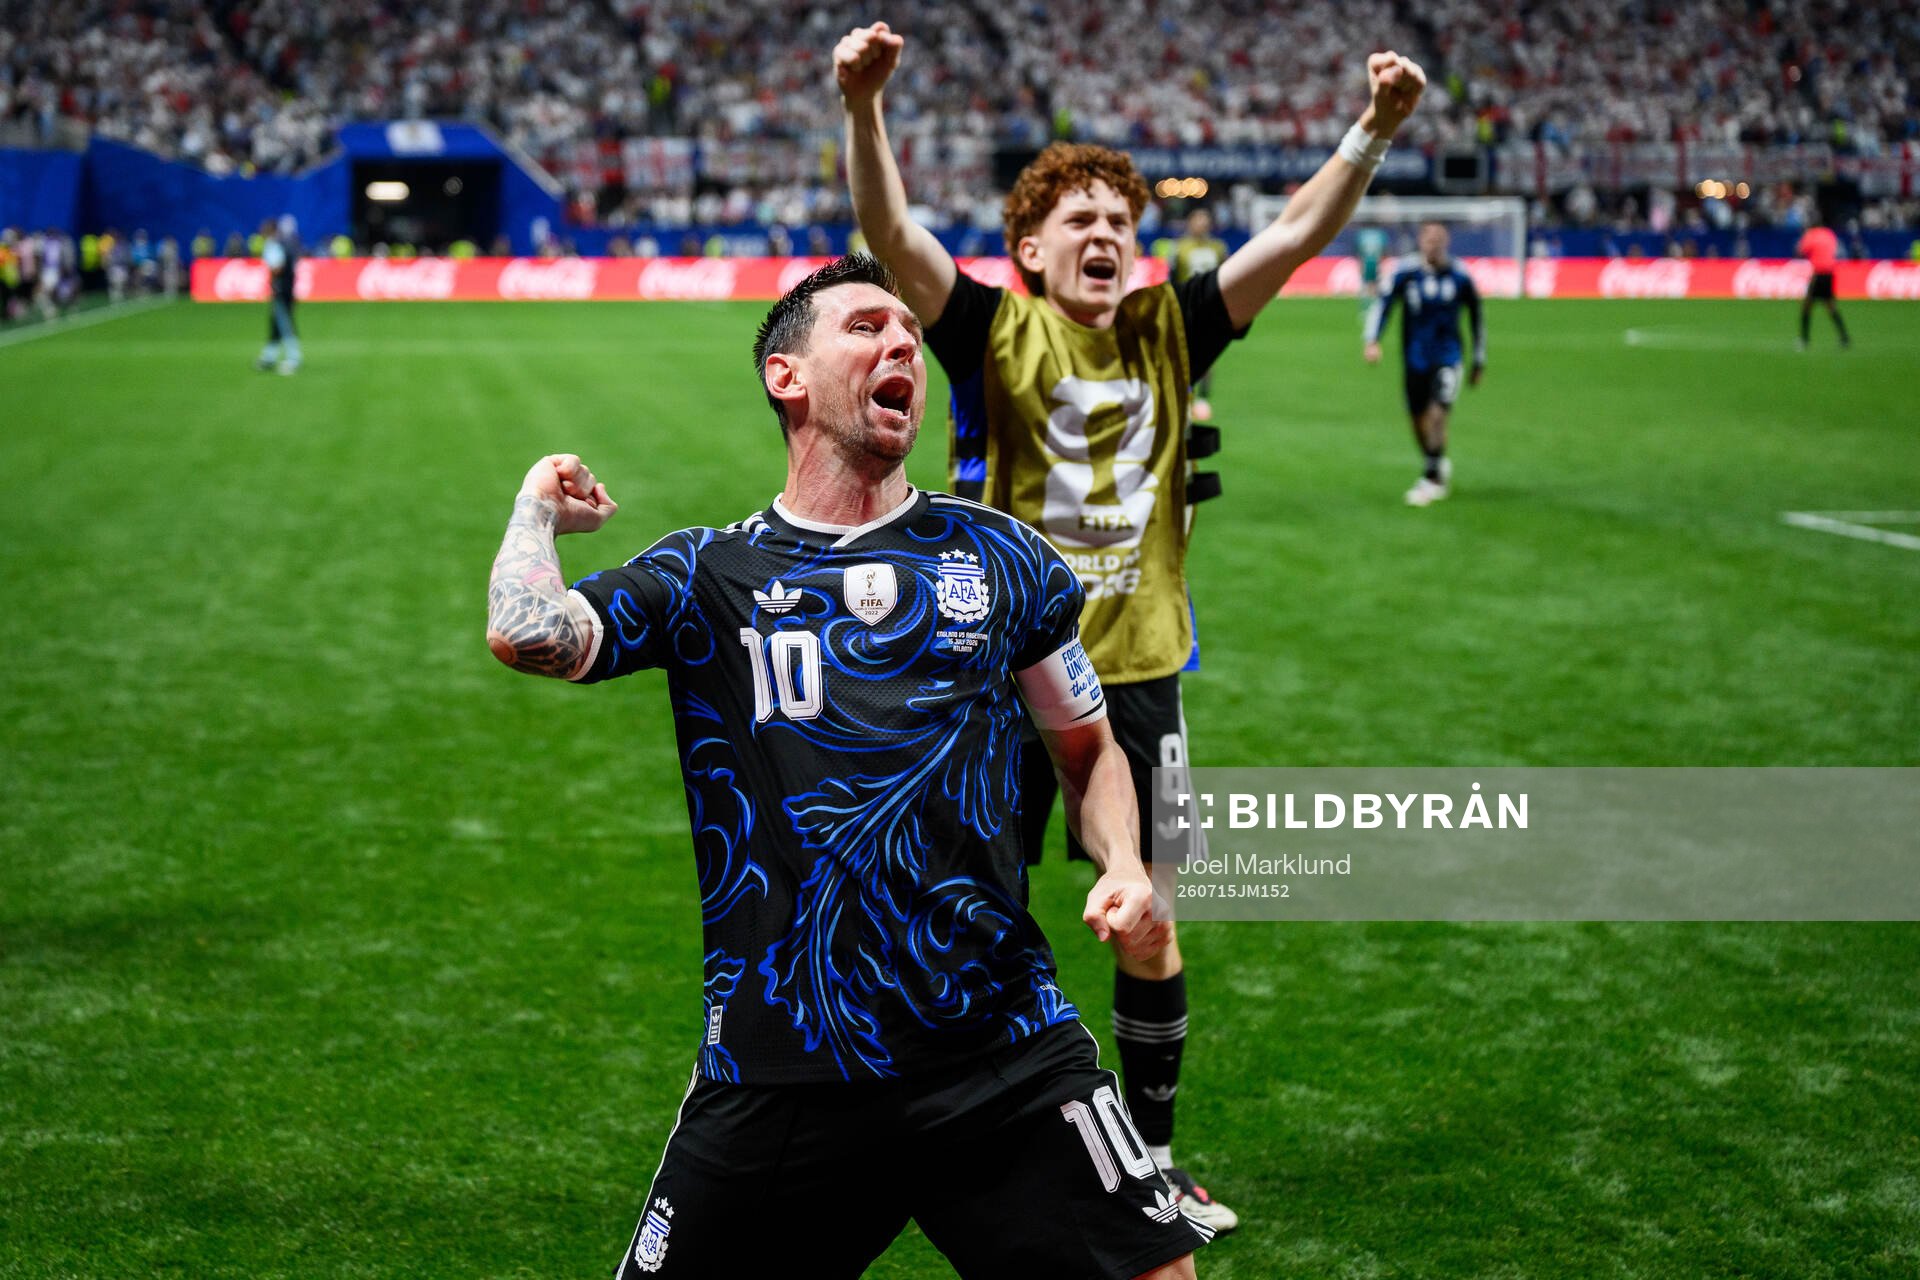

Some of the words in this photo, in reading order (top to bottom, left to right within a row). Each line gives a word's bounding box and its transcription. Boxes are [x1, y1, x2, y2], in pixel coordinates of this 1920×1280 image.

[1079, 515, 1134, 531] FIFA
[1062, 553, 1120, 571] ORLD
[949, 577, 979, 605] AFA
[861, 599, 883, 607] FIFA
[739, 627, 824, 723] 10
[1069, 680, 1088, 698] the
[1060, 1085, 1156, 1193] 10
